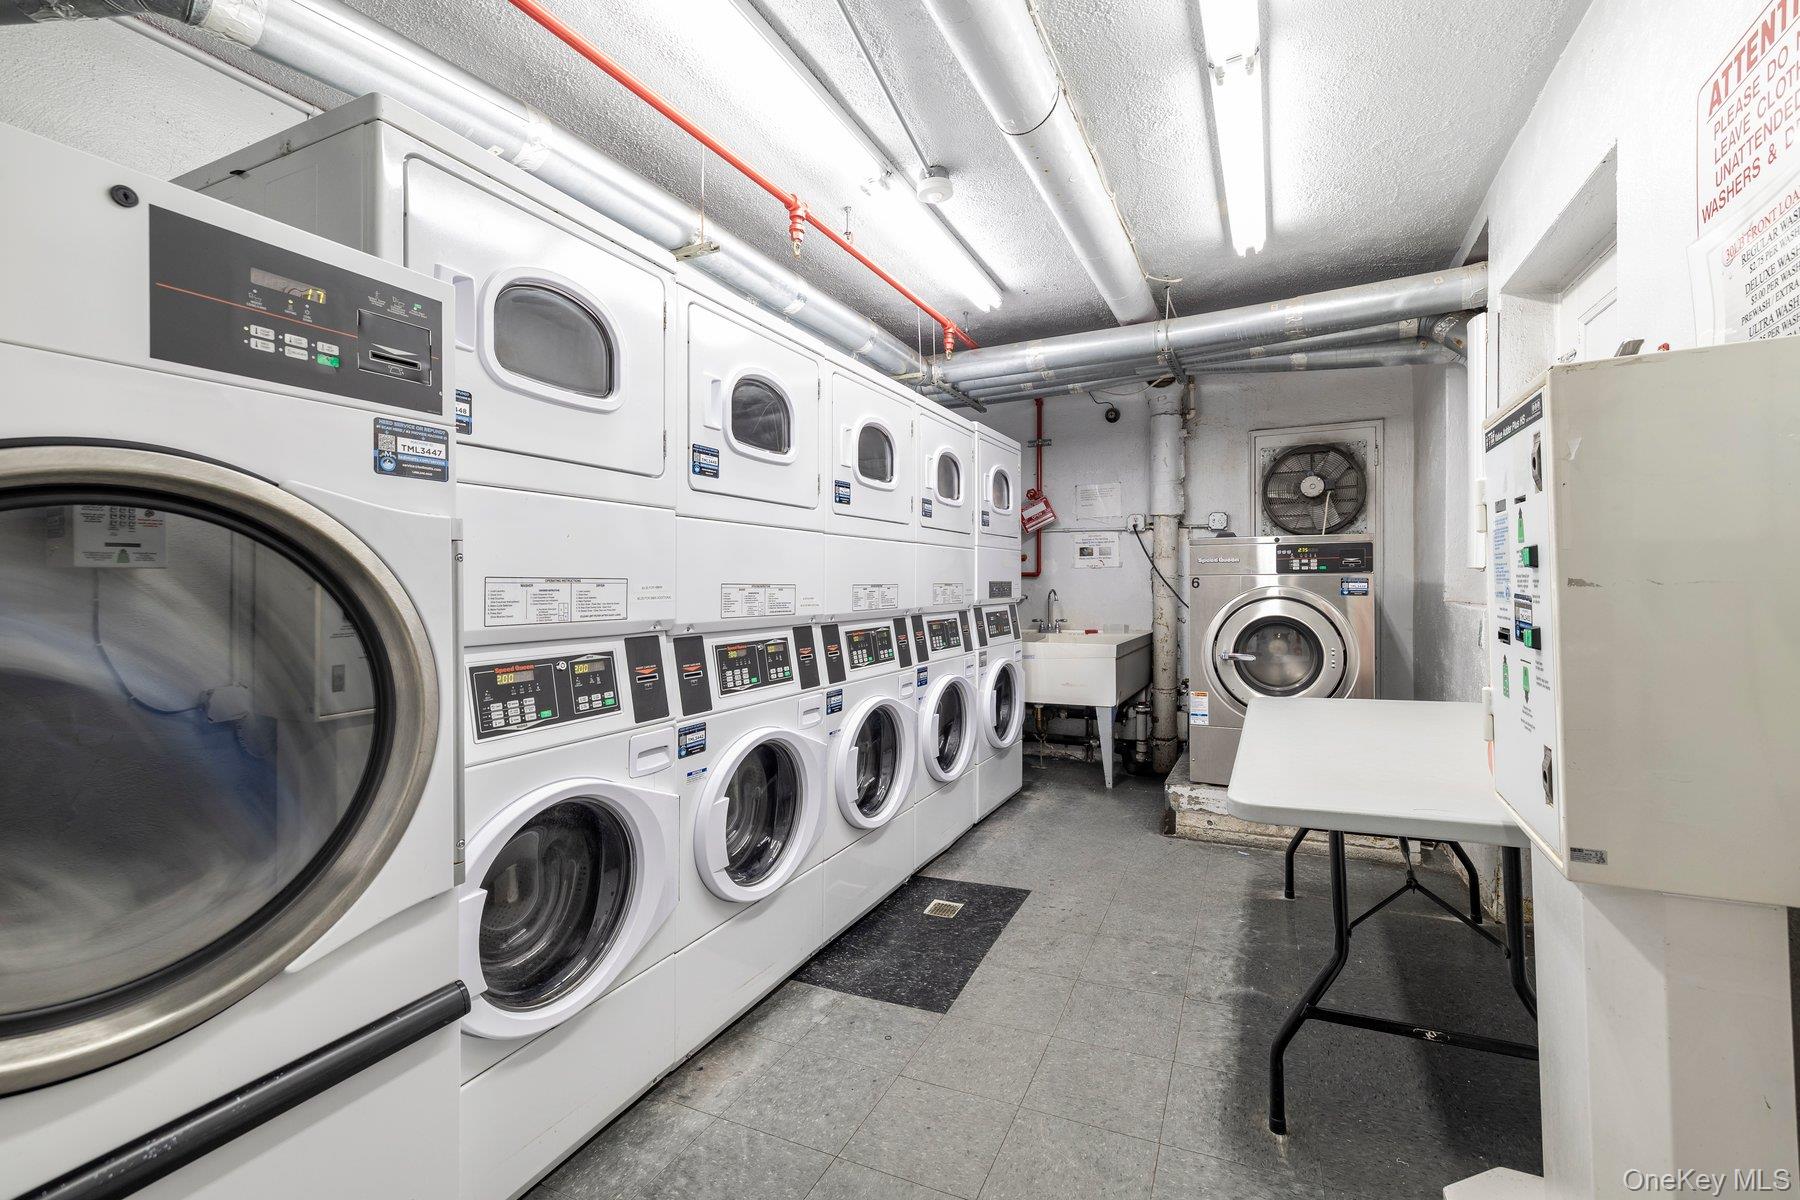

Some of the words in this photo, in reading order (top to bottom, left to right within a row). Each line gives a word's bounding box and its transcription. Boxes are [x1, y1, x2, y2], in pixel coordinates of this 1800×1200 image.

[1714, 75, 1761, 141] PLEASE
[1767, 45, 1789, 83] DO
[1714, 111, 1751, 165] LEAVE
[1702, 157, 1761, 224] WASHERS
[1768, 143, 1777, 165] &
[1741, 227, 1778, 266] REGULAR
[1745, 262, 1776, 295] DELUXE
[1766, 277, 1780, 294] PER
[1741, 297, 1771, 326] PREWASH
[1775, 278, 1800, 303] EXTRA
[1749, 313, 1775, 338] ULTRA
[1775, 294, 1800, 319] WASH
[1767, 325, 1781, 339] PER
[393, 420, 416, 430] SERVICE
[400, 444, 442, 457] TML3447
[1191, 577, 1200, 589] 6
[494, 665, 515, 675] Speed
[514, 663, 534, 672] Queen
